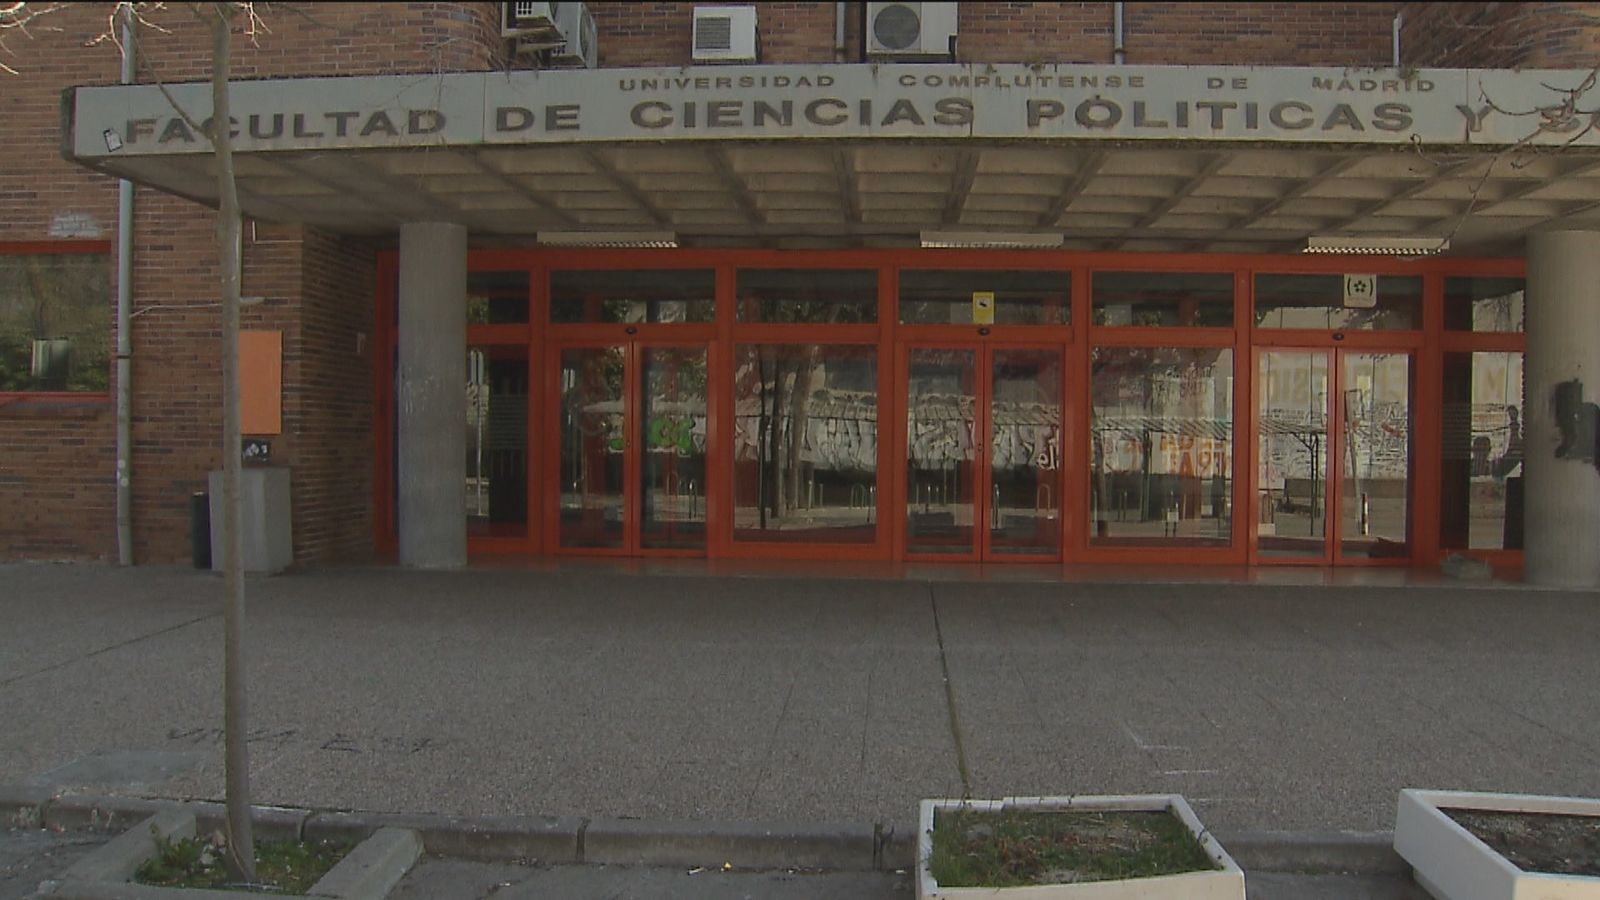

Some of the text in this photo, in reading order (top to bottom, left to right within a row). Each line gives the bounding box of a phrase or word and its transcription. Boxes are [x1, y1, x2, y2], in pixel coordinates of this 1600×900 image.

[620, 74, 1435, 93] UNIVERSIDAD COMPLUTENSE DE MADRID
[126, 109, 446, 144] FACULTAD
[496, 105, 580, 132] DE
[631, 98, 974, 130] CIENCIAS
[1026, 98, 1413, 131] POLITICAS
[1455, 104, 1491, 132] Y
